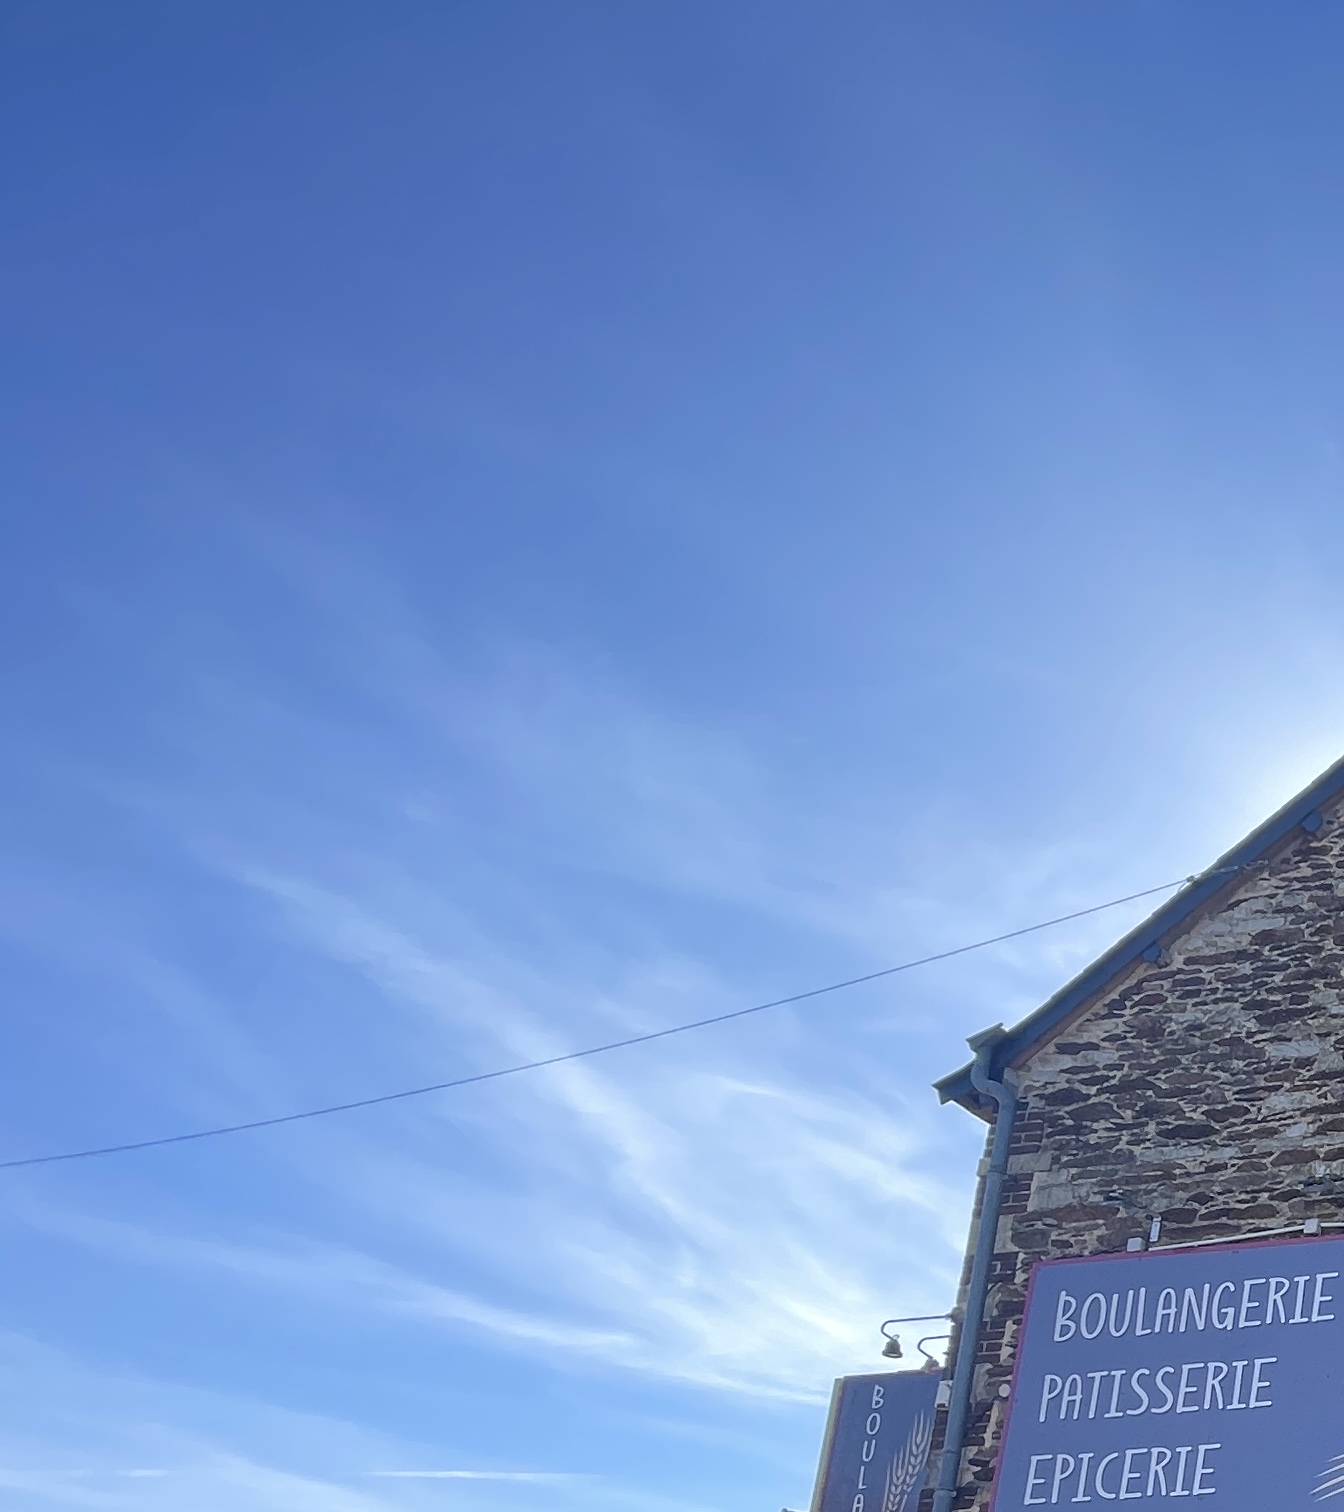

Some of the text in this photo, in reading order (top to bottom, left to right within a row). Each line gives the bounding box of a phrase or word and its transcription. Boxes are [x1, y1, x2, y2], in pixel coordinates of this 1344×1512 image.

[1053, 1272, 1339, 1342] BOULANGERIE
[1038, 1357, 1277, 1422] PATISSERIE
[1024, 1443, 1221, 1505] EPICERIE
